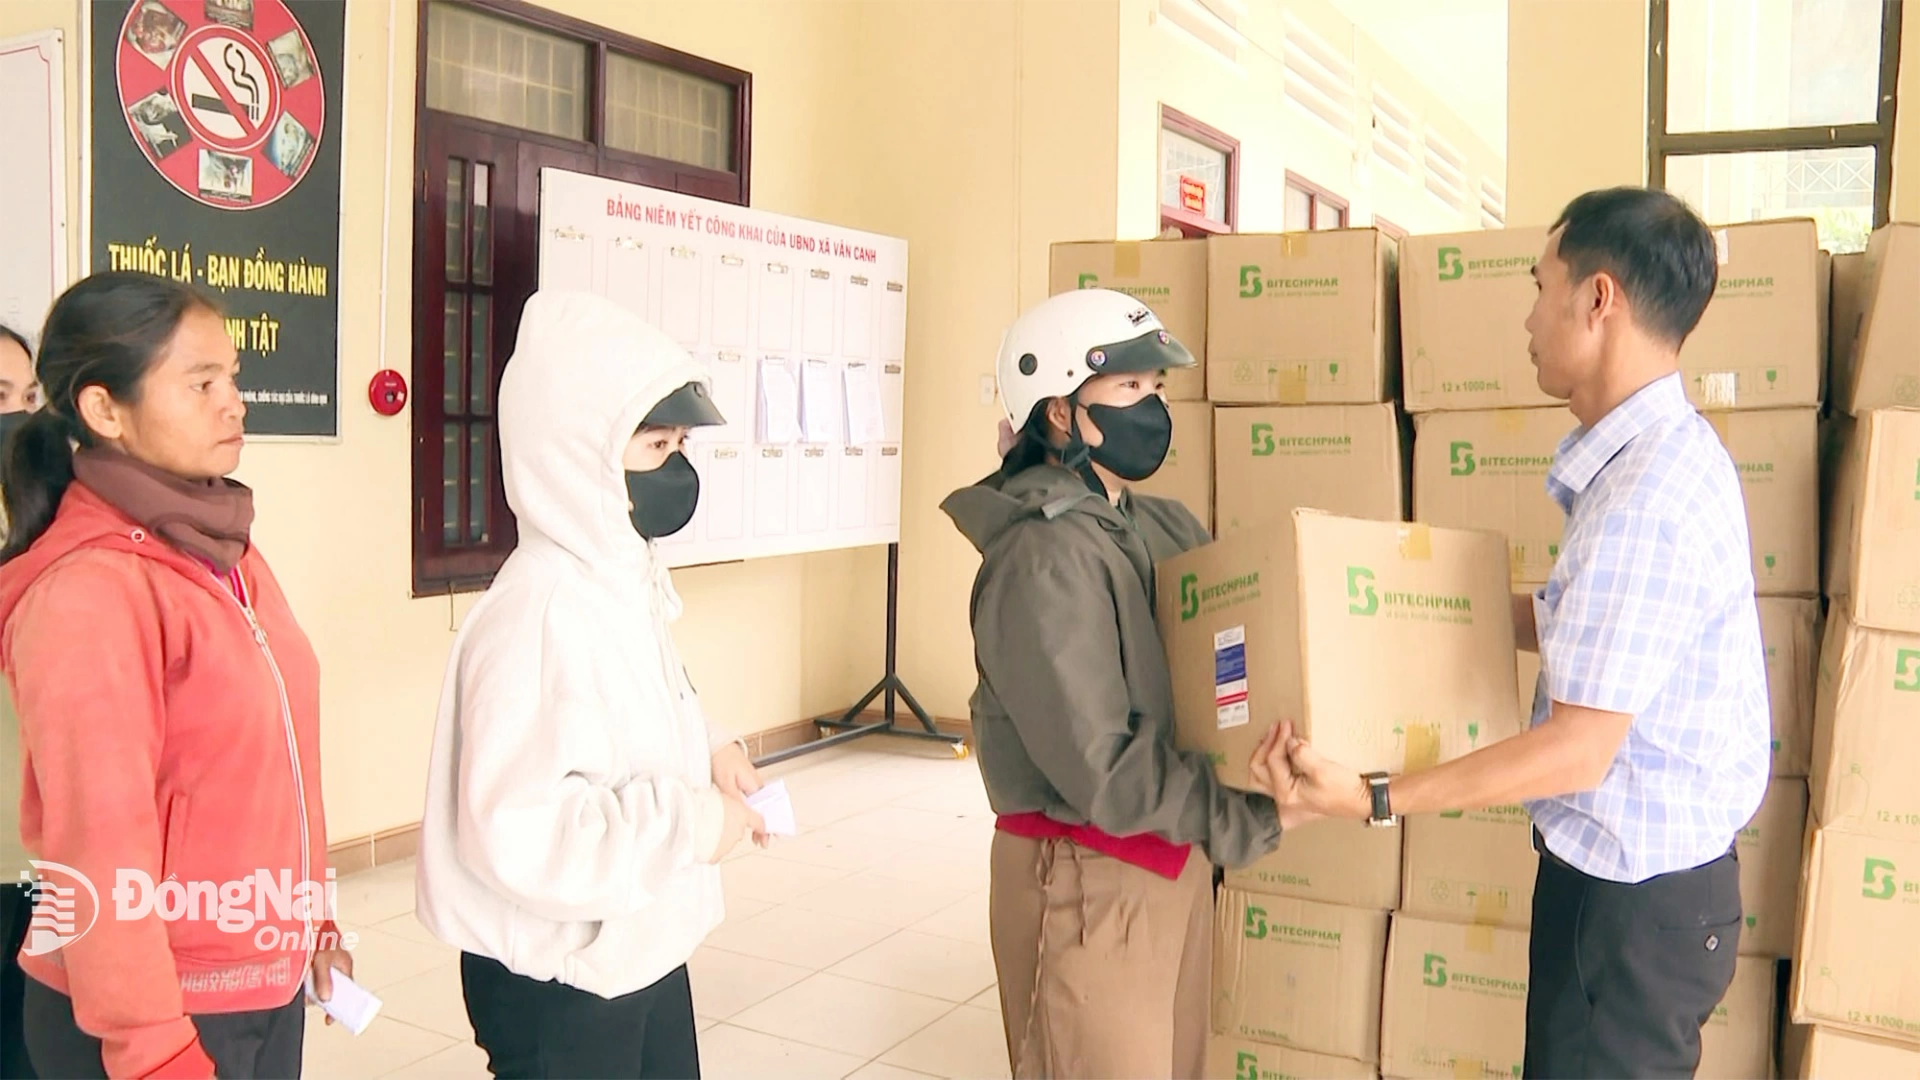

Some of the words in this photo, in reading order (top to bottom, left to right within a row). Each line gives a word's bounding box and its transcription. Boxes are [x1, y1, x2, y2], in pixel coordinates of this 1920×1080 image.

[606, 193, 642, 221] BẢNG
[645, 204, 677, 228] NIÊM
[680, 207, 702, 232] YẾT
[706, 214, 736, 238] CÔNG
[738, 223, 763, 243] KHAI
[766, 225, 786, 247] CỦA
[789, 233, 816, 253] UBND
[818, 237, 831, 256] XÃ
[853, 245, 877, 264] CANH
[108, 235, 166, 277] THUỐC
[171, 243, 192, 284] LÁ
[207, 253, 240, 294] BẠN
[243, 246, 285, 293] ĐỒNG
[287, 256, 327, 297] HÀNH
[1468, 256, 1537, 271] BITECHPHA
[1266, 277, 1339, 289] BITECHPHAR
[1719, 277, 1774, 289] CHPHAR
[225, 318, 246, 351] NH
[250, 312, 279, 358] TẬT
[1442, 381, 1453, 393] 12
[1279, 436, 1352, 447] BITECHPHAR
[1202, 571, 1260, 602] BITECHPHAR
[1383, 591, 1472, 612] BITECHPHAR
[1877, 810, 1890, 822] 12
[1905, 814, 1920, 825] 10
[1271, 924, 1341, 942] BITECHPHAR
[1451, 972, 1528, 992] BITECHPHAR
